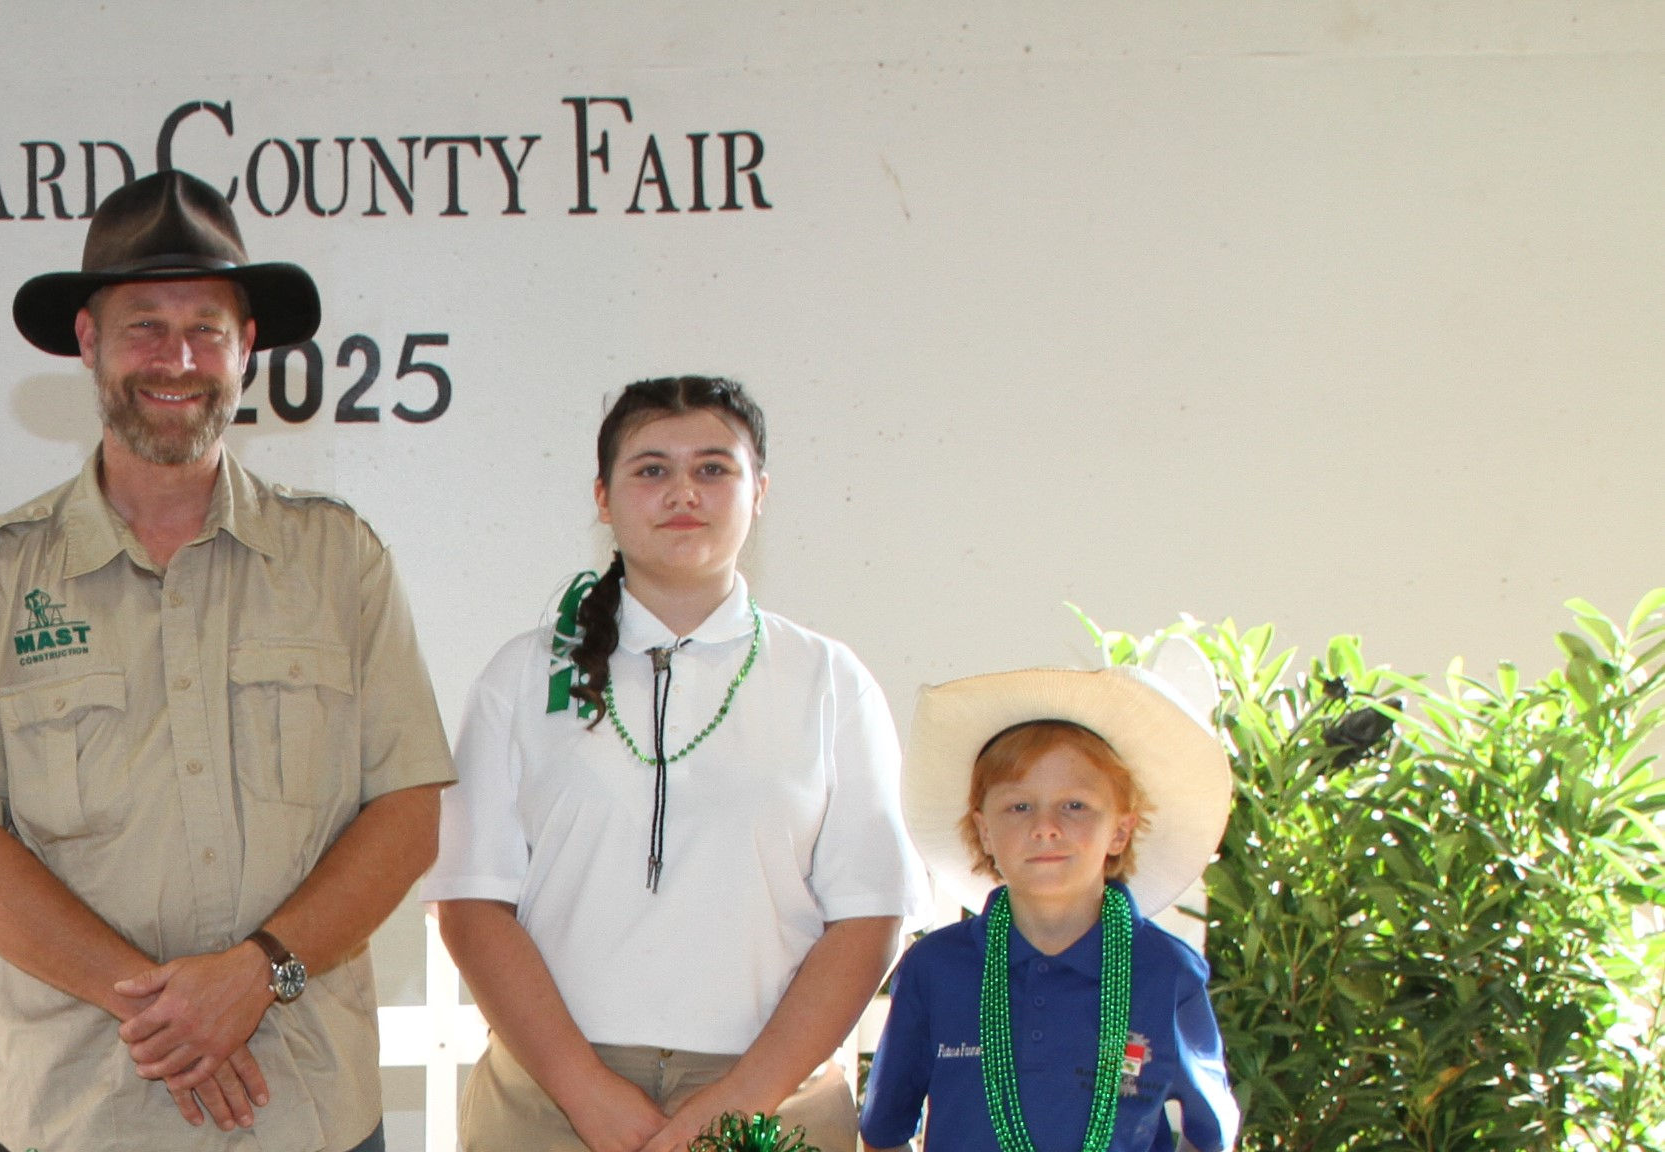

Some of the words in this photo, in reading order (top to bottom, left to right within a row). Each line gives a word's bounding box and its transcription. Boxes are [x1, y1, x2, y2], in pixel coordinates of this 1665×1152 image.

[563, 96, 772, 215] FAIR
[14, 625, 91, 655] MAST
[19, 646, 89, 667] CONSTRUCTION
